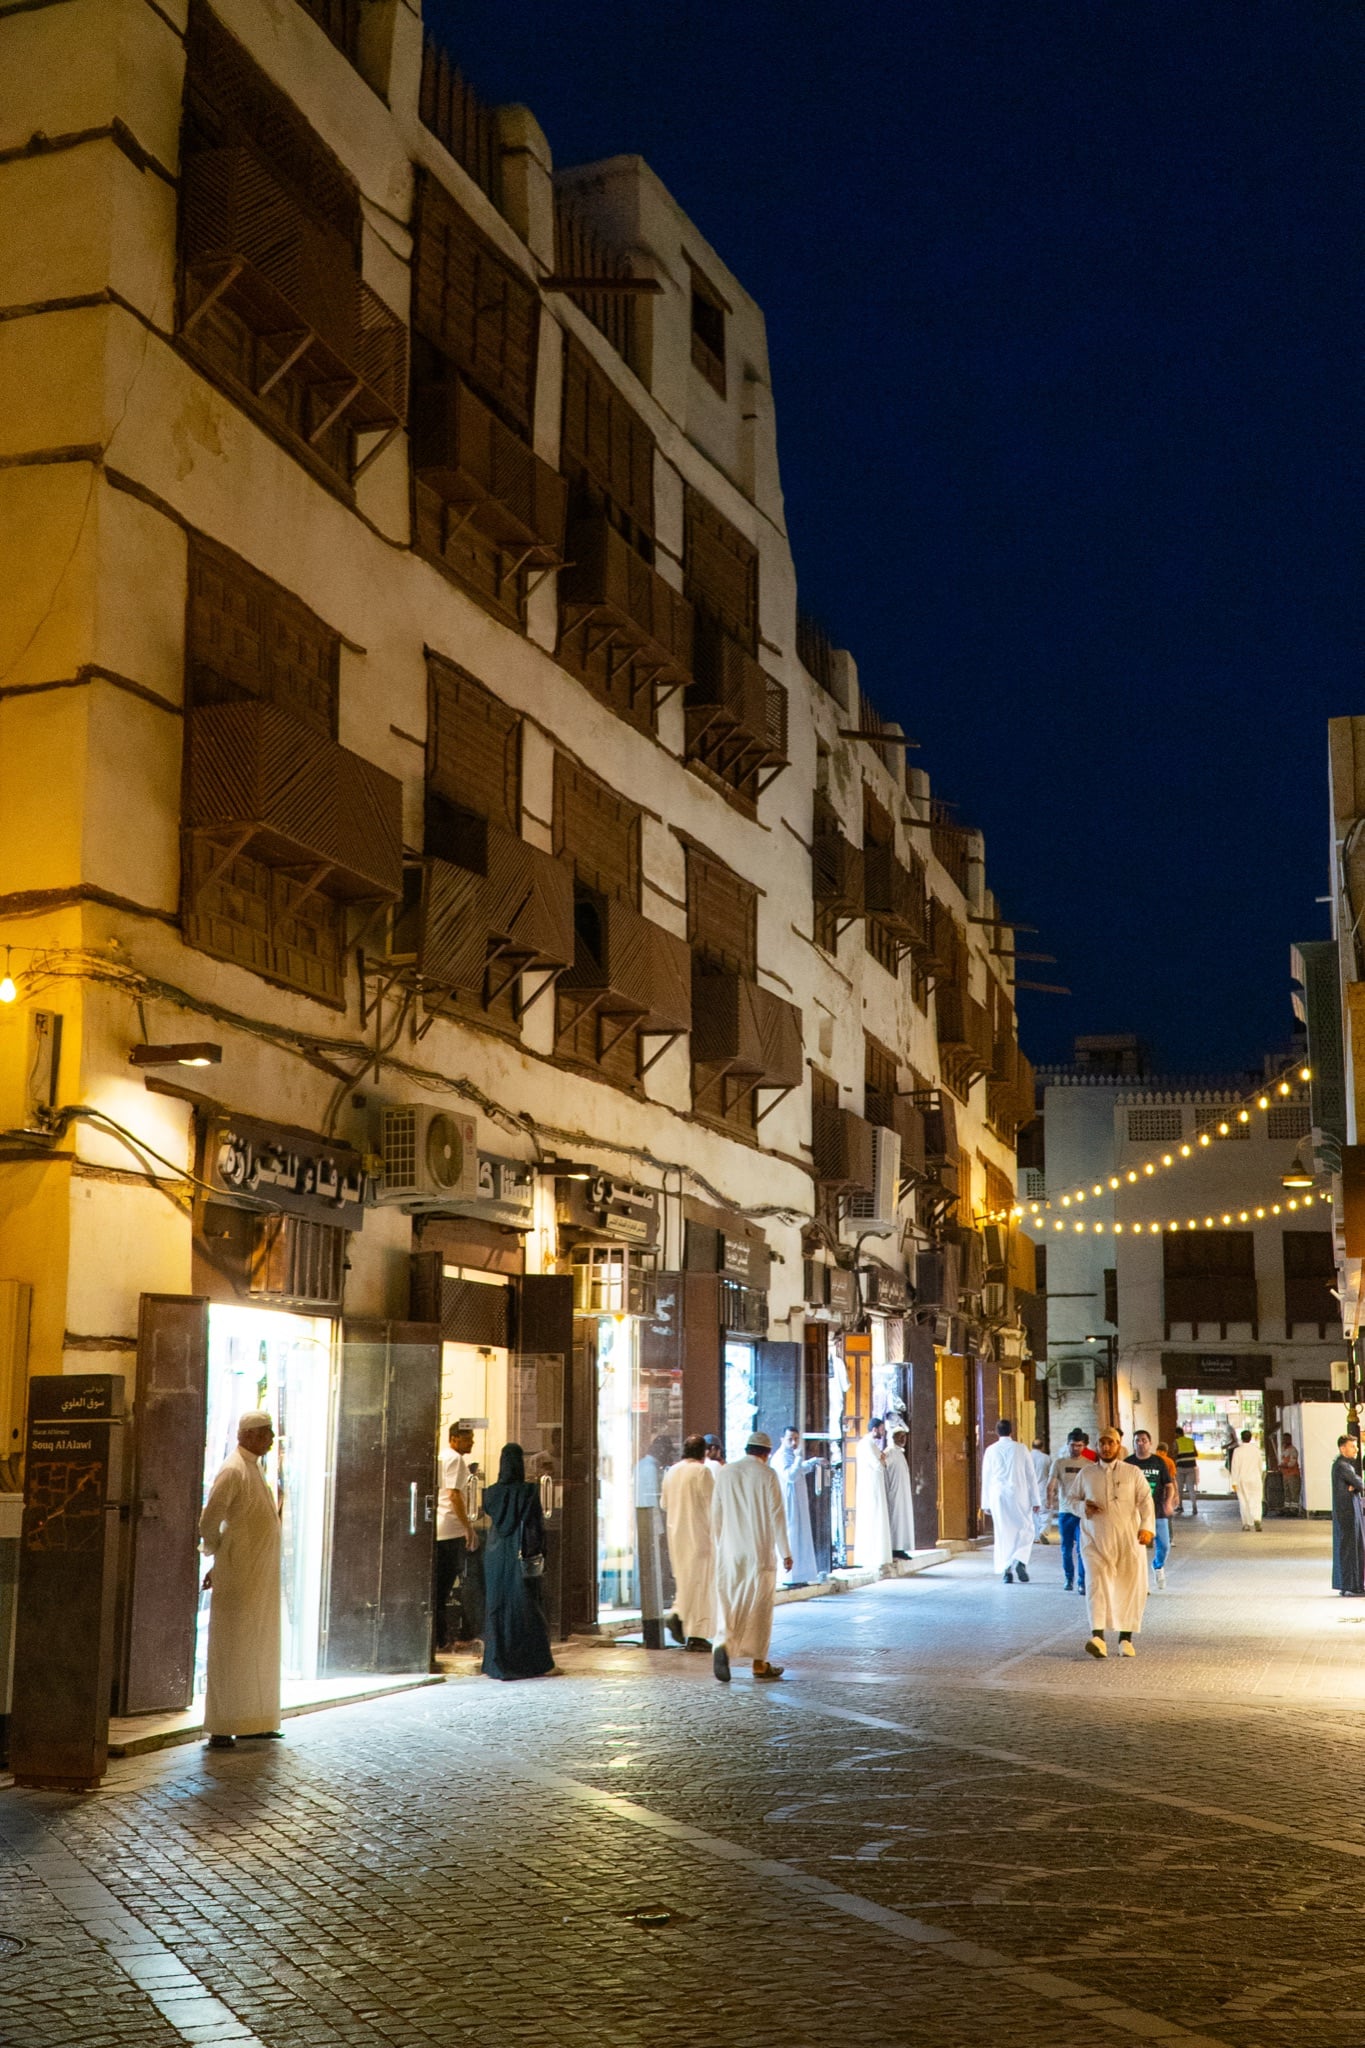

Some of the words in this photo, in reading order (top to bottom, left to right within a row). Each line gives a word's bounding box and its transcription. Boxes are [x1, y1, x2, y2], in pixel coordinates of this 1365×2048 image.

[61, 1397, 86, 1413] العلوي
[87, 1398, 105, 1410] سوق
[32, 1441, 54, 1452] Souq
